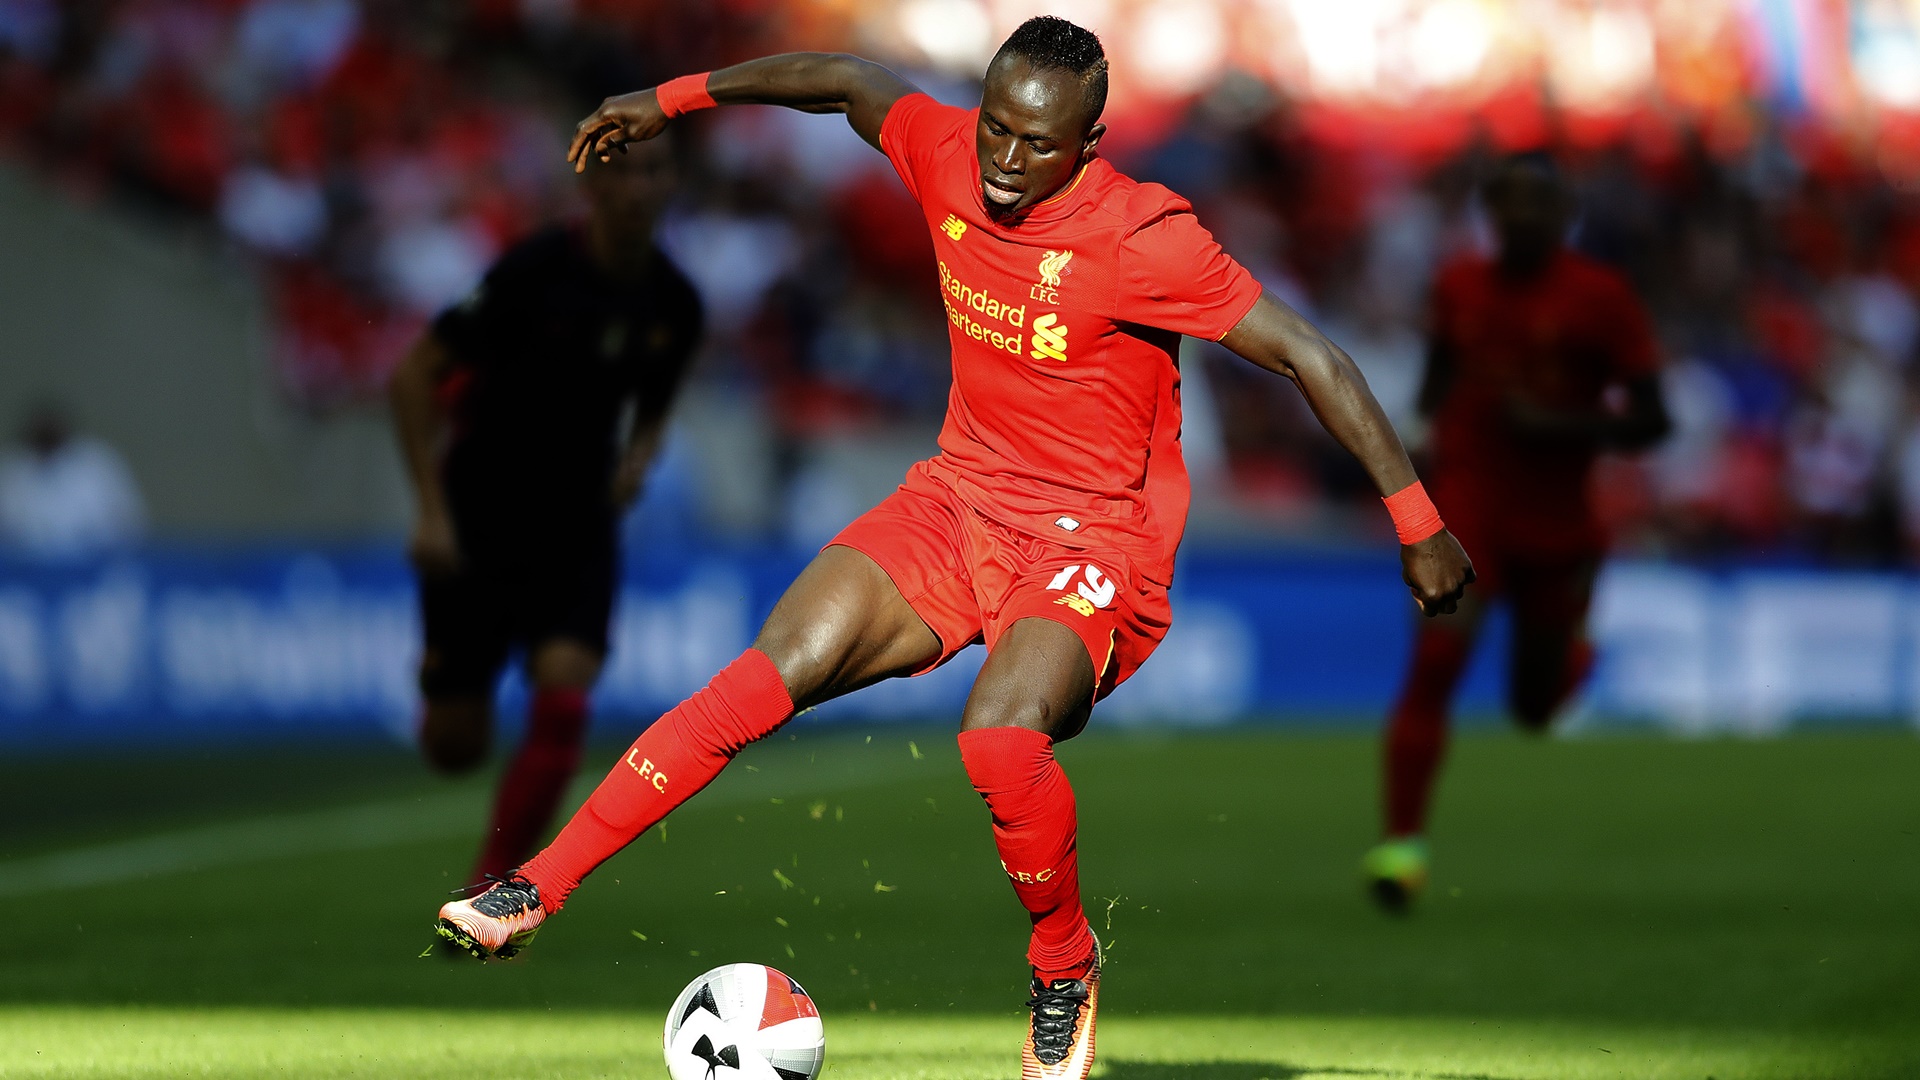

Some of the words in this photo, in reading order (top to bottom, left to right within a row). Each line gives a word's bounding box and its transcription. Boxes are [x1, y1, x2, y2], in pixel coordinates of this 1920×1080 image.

[939, 261, 1025, 328] Standard
[1029, 286, 1060, 305] L.F.C.
[944, 293, 1022, 355] hartered
[1045, 564, 1116, 608] 19
[626, 747, 668, 794] L.F.C.
